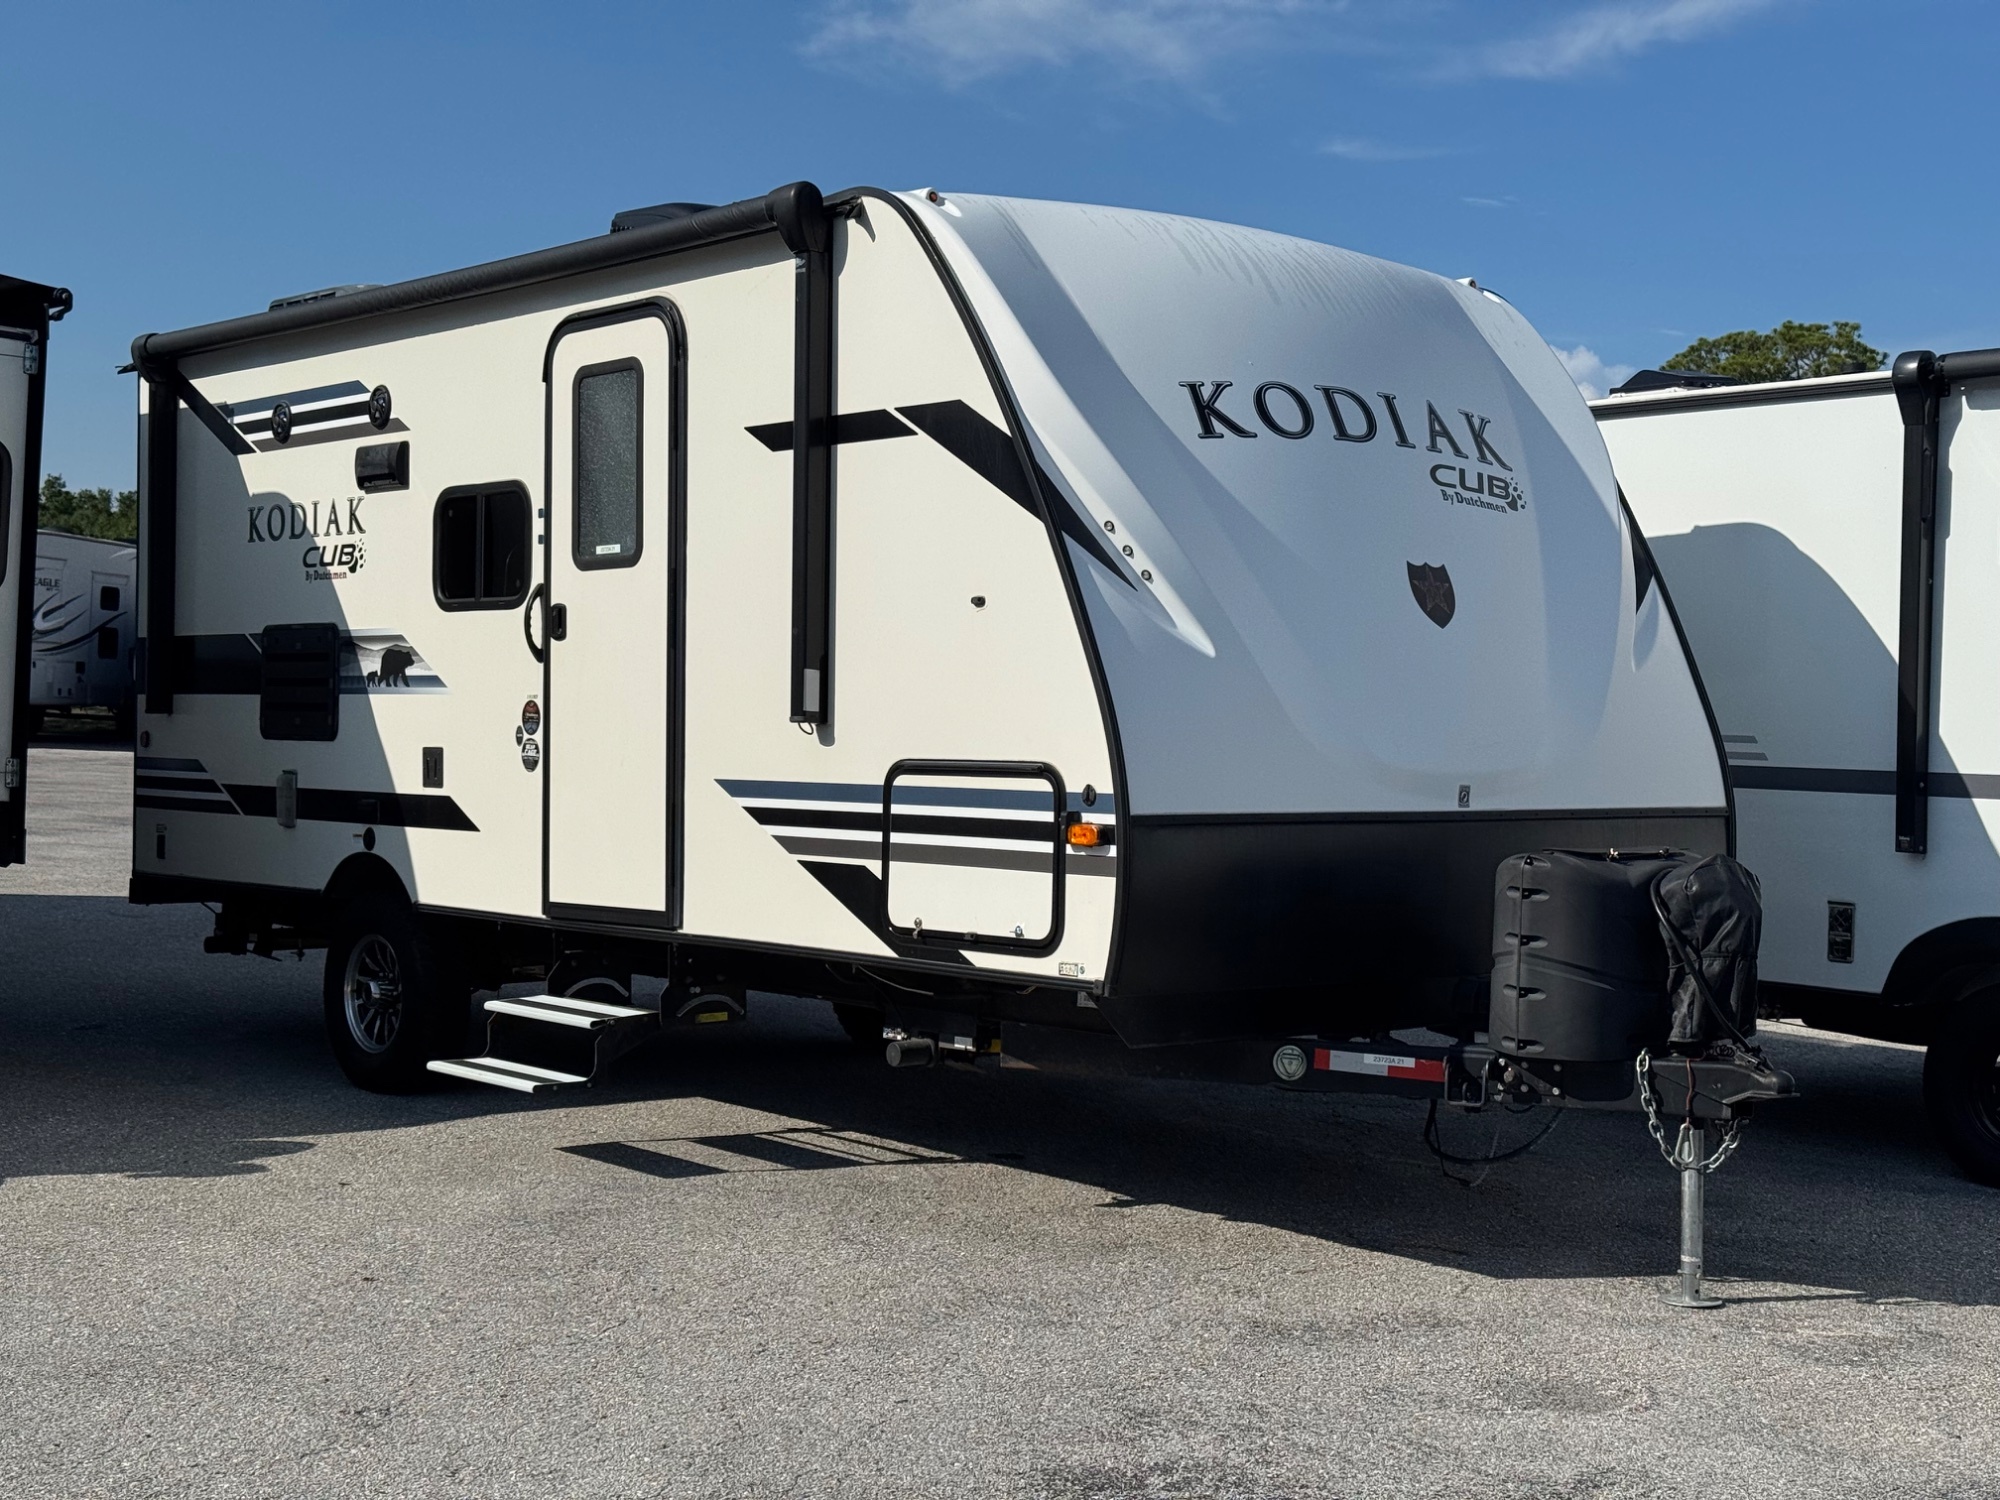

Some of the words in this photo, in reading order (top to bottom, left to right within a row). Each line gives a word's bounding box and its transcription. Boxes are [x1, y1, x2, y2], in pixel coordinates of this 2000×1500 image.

[1178, 380, 1513, 472] KODIAK
[1429, 463, 1511, 500] CUB
[1440, 489, 1454, 505] By
[1454, 491, 1508, 514] Dutchmen
[247, 496, 366, 543] KODIAK
[302, 543, 357, 568] CUB
[305, 570, 313, 584] By
[313, 570, 347, 581] Dutchmen
[1373, 1056, 1396, 1064] 23723A
